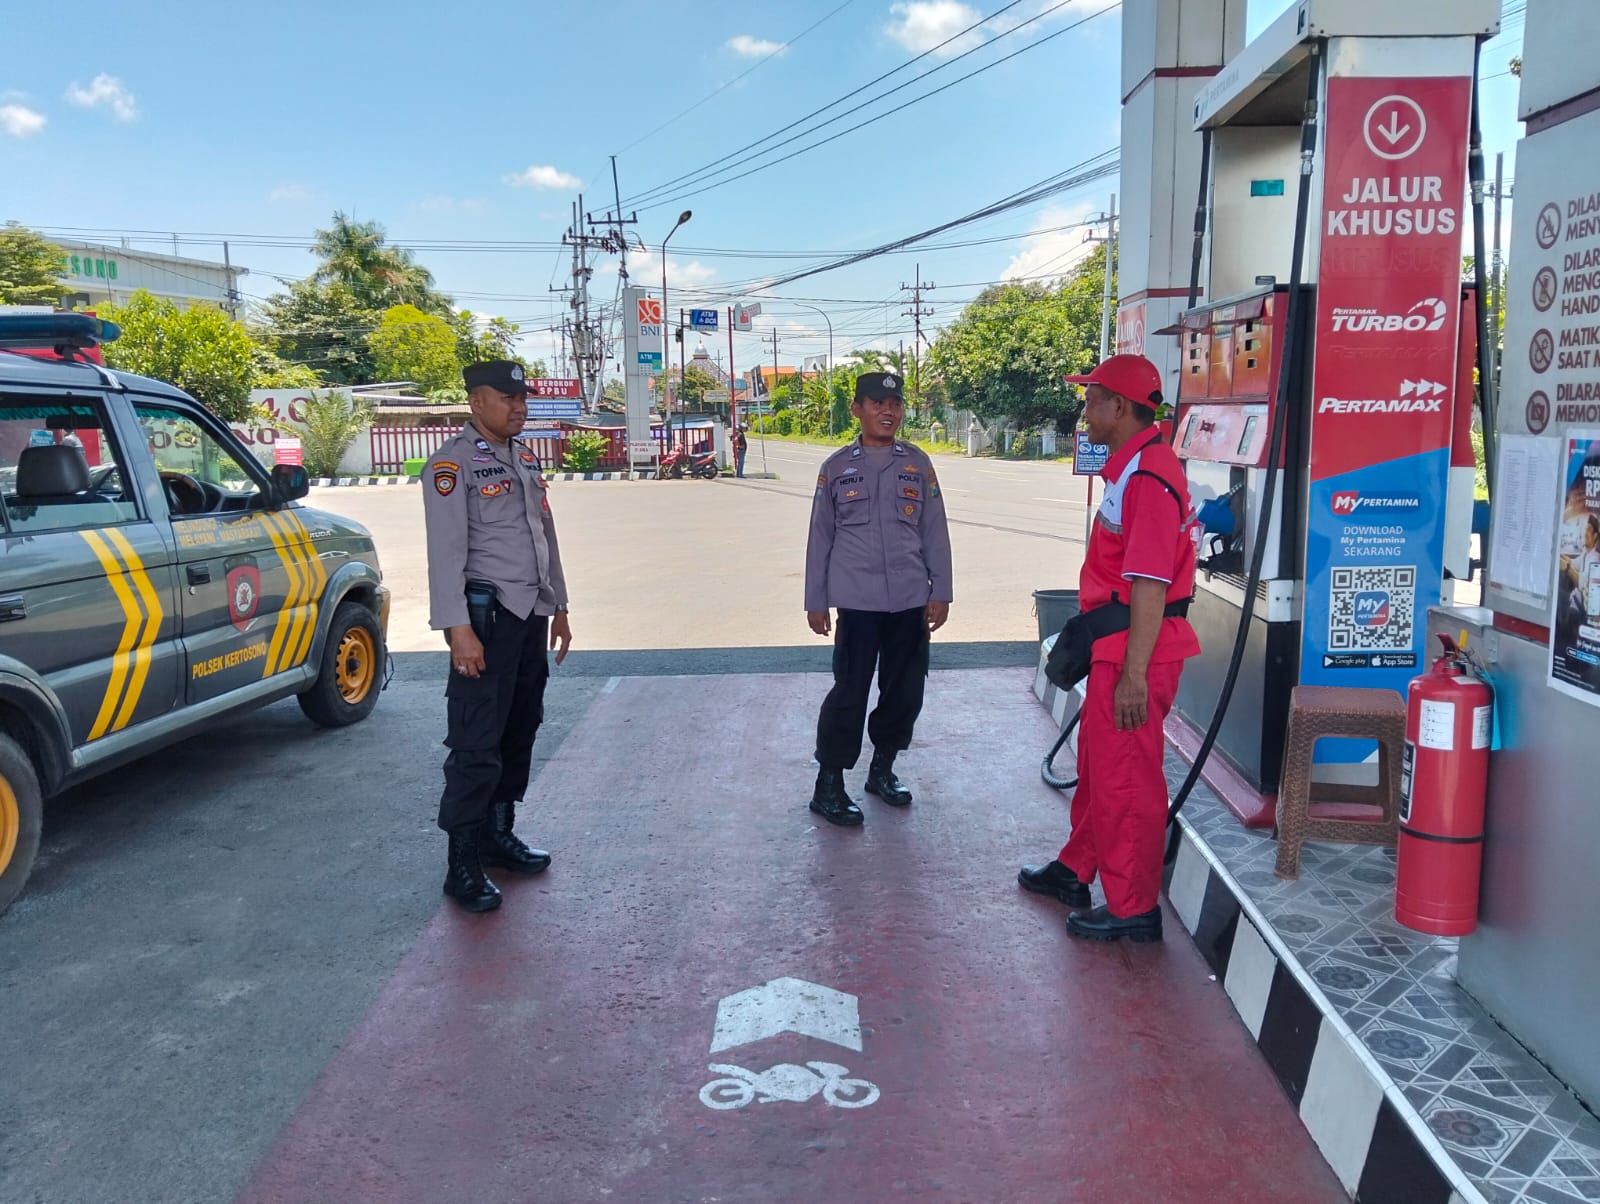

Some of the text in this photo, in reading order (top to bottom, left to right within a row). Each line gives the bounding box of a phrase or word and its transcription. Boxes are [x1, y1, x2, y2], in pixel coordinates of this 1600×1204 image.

[1343, 176, 1442, 204] JALUR
[1327, 207, 1456, 236] KHUSUS
[1332, 315, 1427, 332] TURBO
[640, 325, 660, 337] BNI
[1558, 350, 1590, 369] SAAT
[539, 387, 568, 395] SPBU
[1318, 397, 1443, 413] PERTAMAX
[1334, 496, 1419, 513] My PERTAMINA
[1343, 526, 1403, 535] DOWNLOAD
[1340, 536, 1406, 546] My Pertamina
[1343, 546, 1401, 556] SEKARANG
[192, 641, 267, 680] POLSEK KERTOSONO
[1335, 658, 1354, 666] Google
[1383, 658, 1396, 666] App
